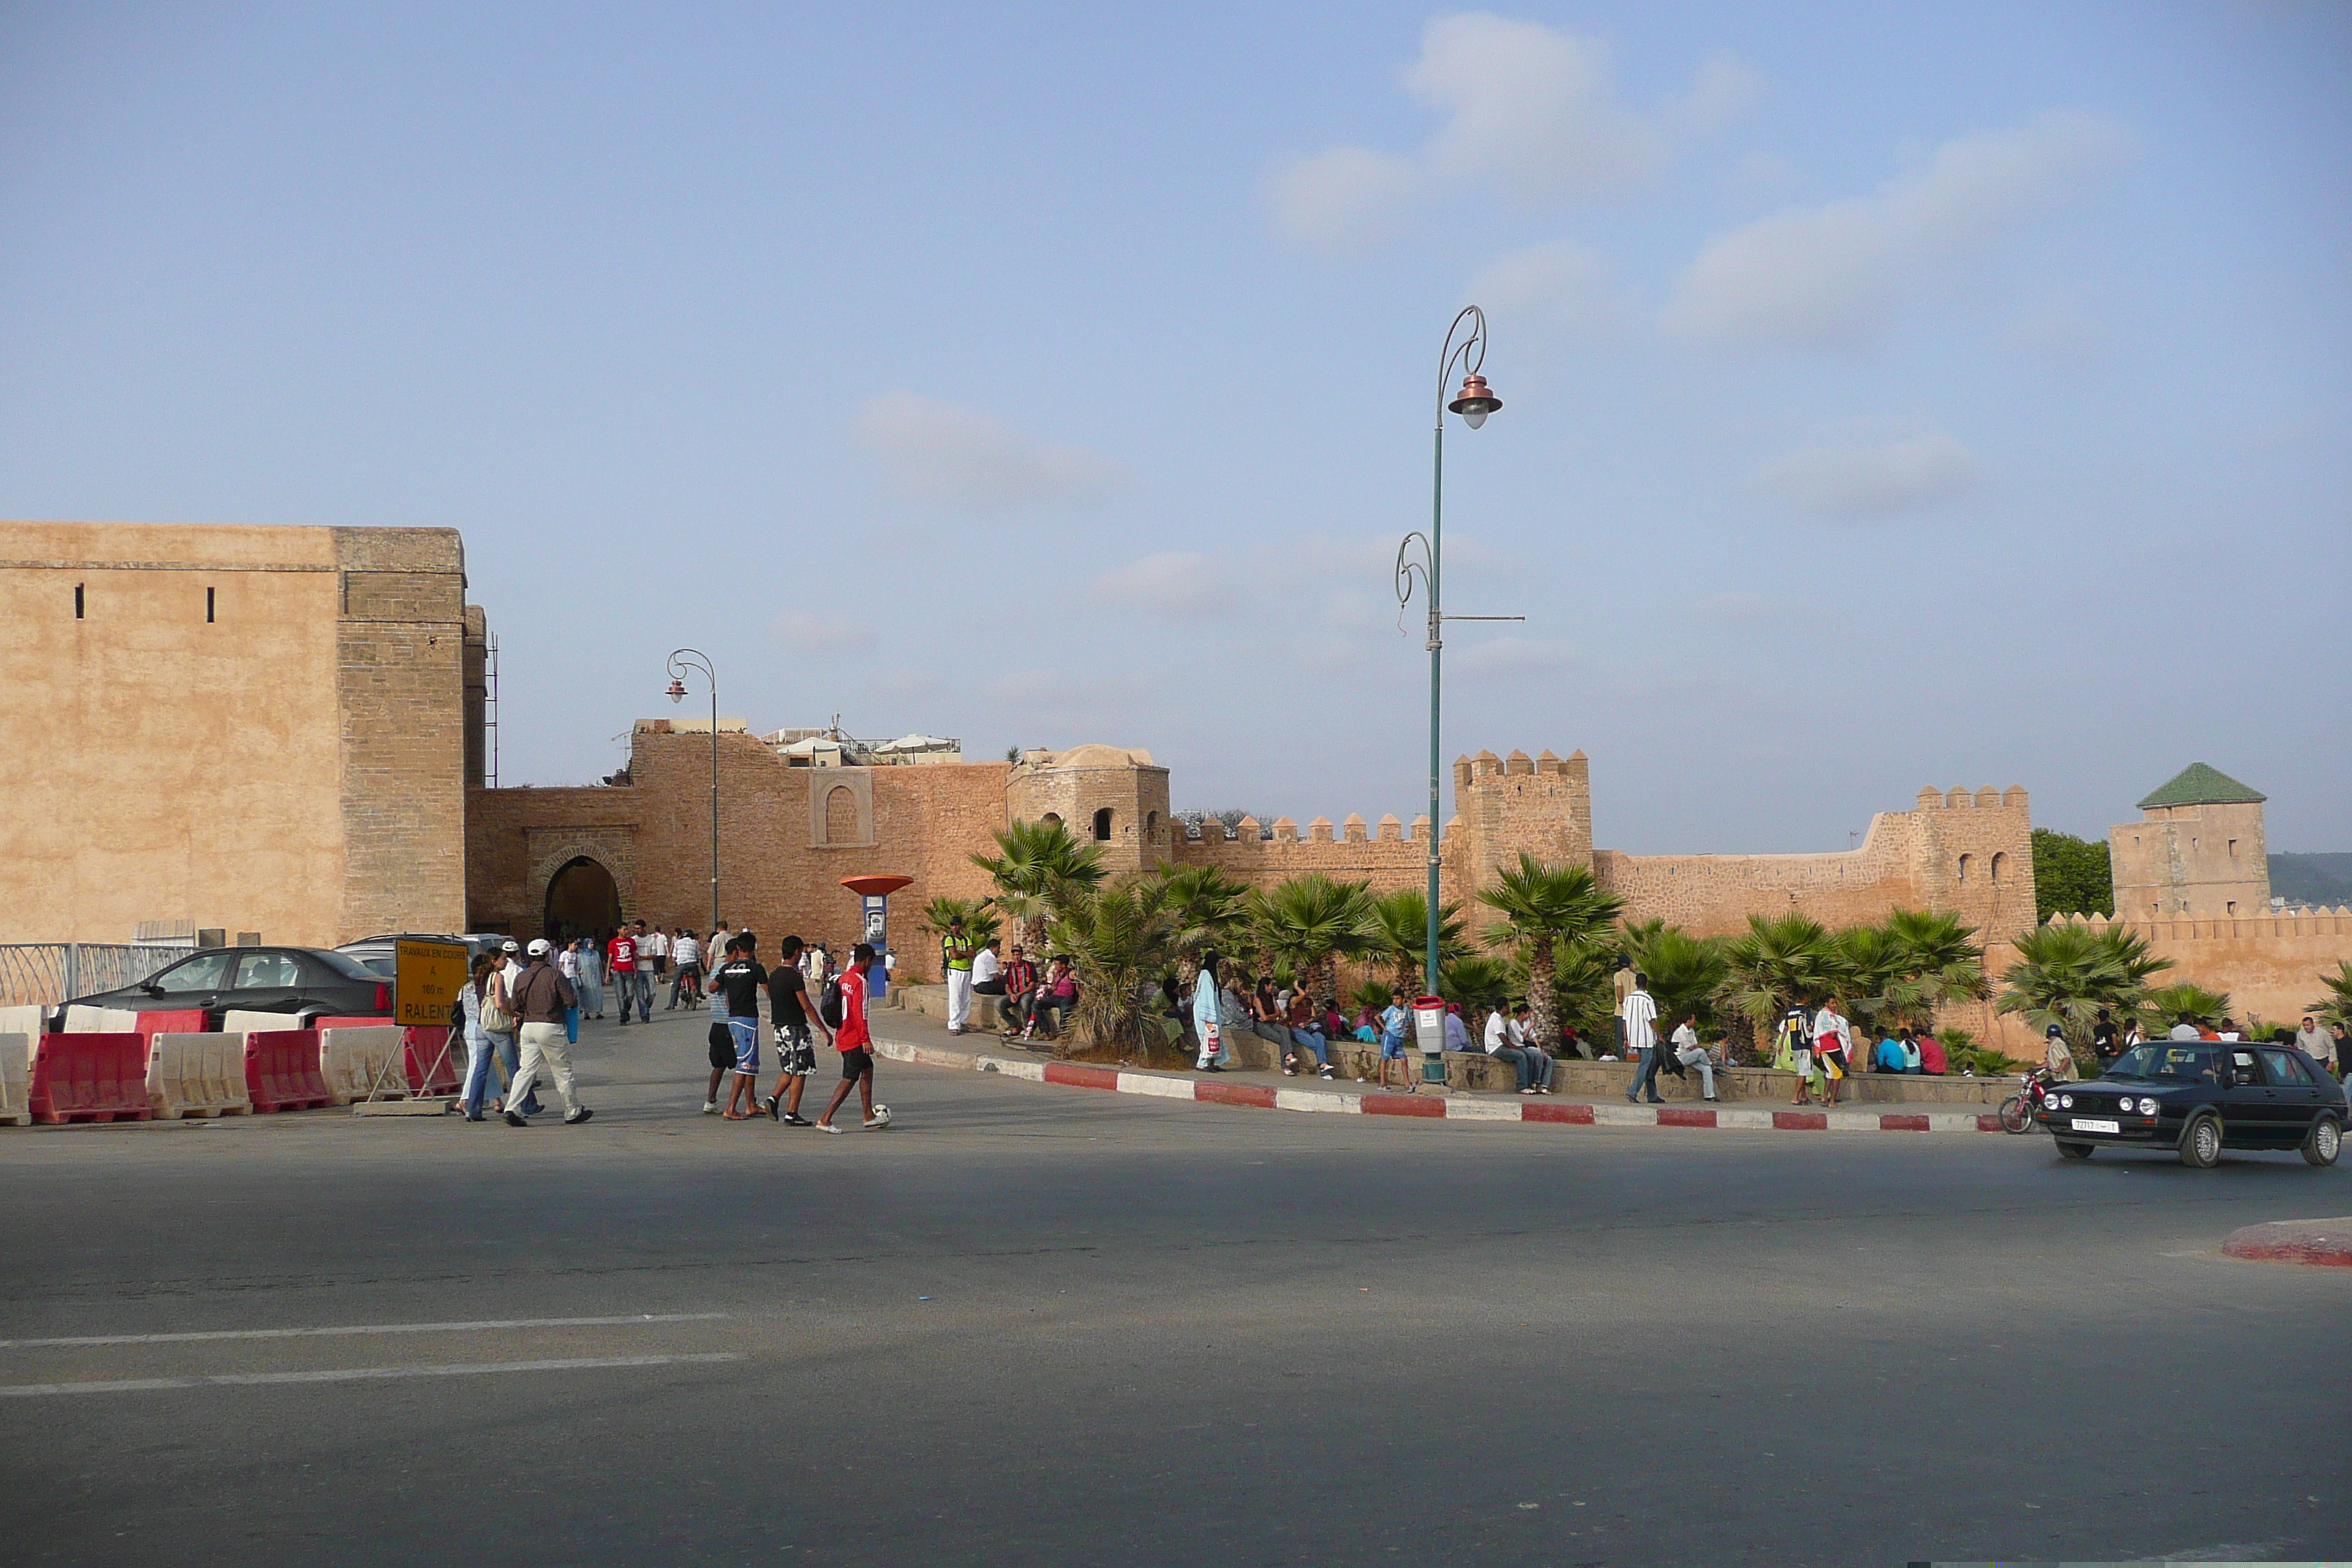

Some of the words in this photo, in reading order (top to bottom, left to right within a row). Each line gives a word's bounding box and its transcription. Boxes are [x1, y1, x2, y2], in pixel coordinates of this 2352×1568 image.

[399, 946, 431, 957] TRAVAUX
[432, 949, 442, 958] EN
[443, 950, 466, 960] COURS
[430, 966, 436, 976] A
[422, 984, 435, 995] 100
[405, 1003, 452, 1019] RALENT
